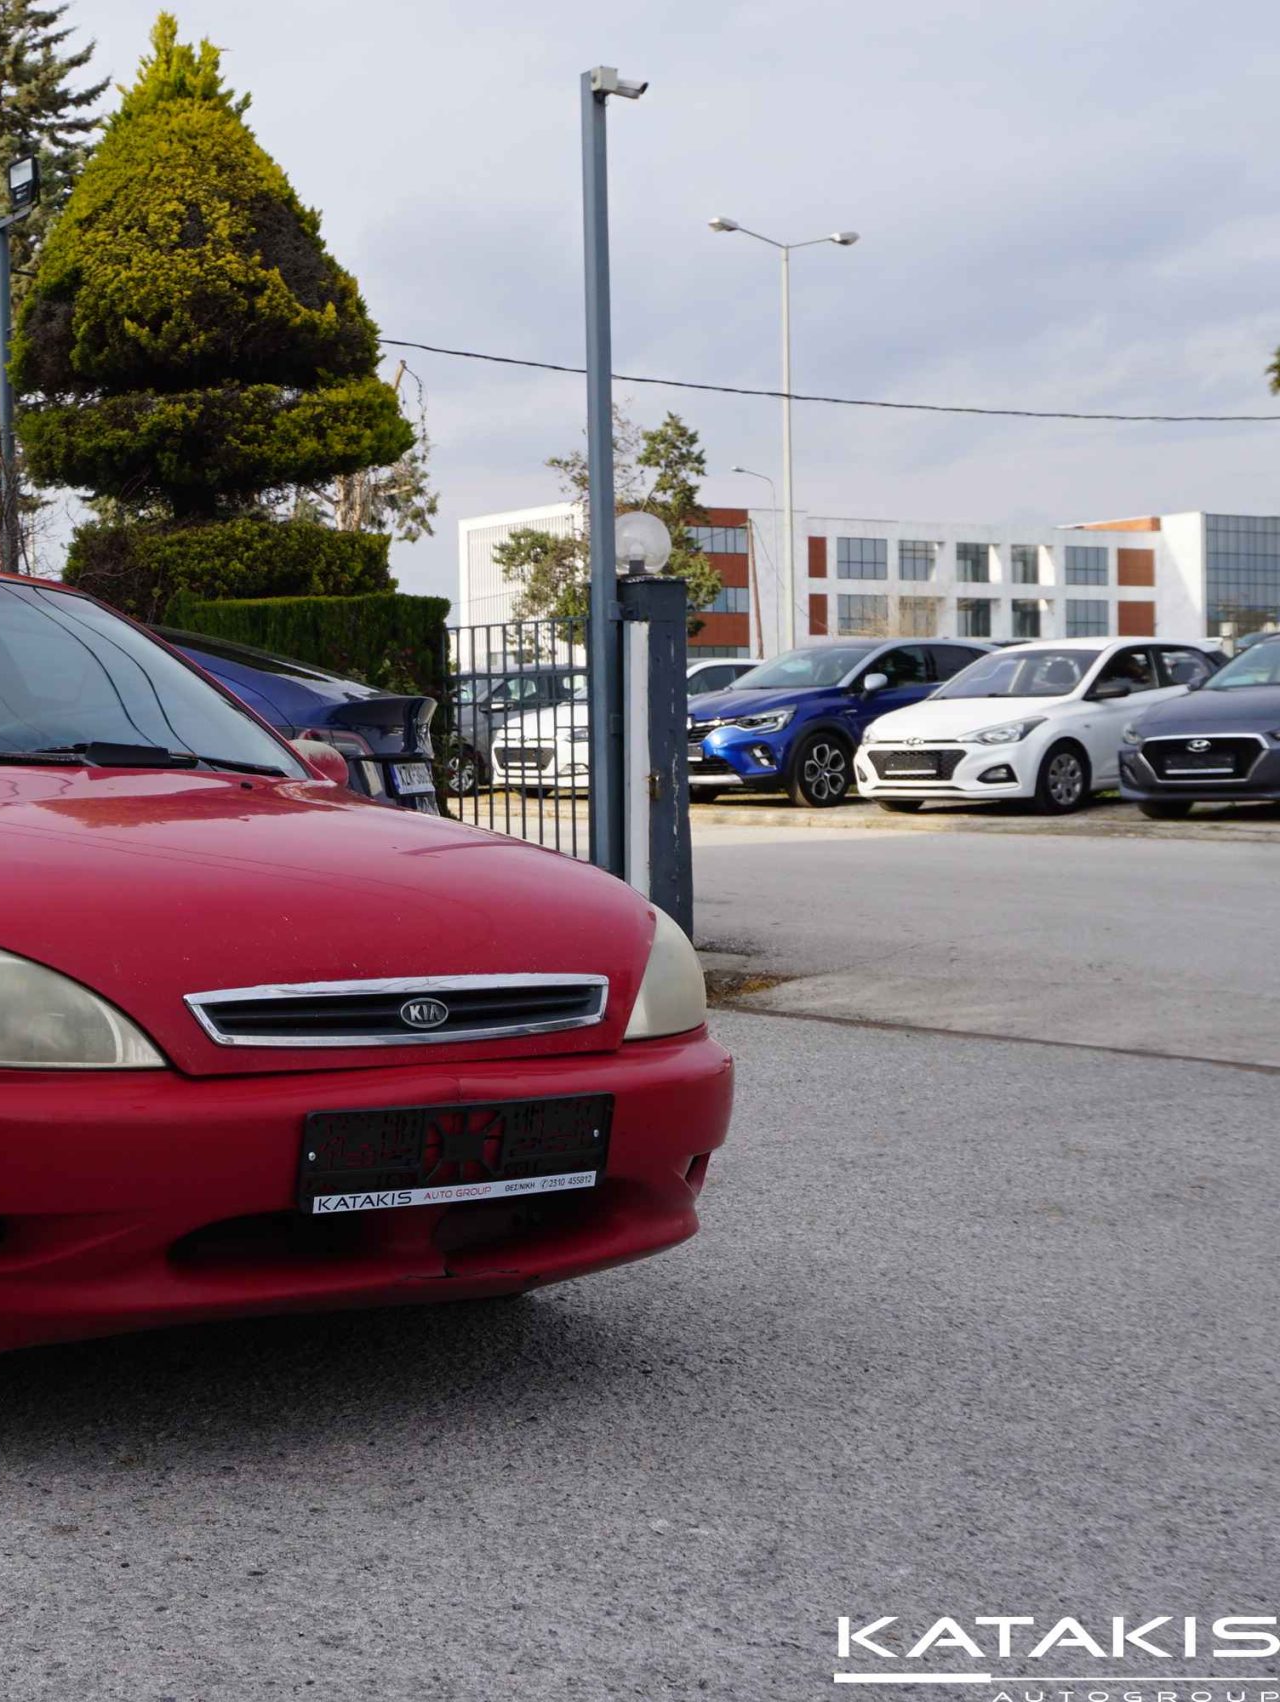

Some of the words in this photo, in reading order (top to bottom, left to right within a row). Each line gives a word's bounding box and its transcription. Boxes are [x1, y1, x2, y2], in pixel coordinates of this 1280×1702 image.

[409, 1004, 441, 1021] KIA
[317, 1191, 412, 1211] KATAKIS
[423, 1190, 453, 1201] AUTO
[455, 1185, 492, 1198] GROUP
